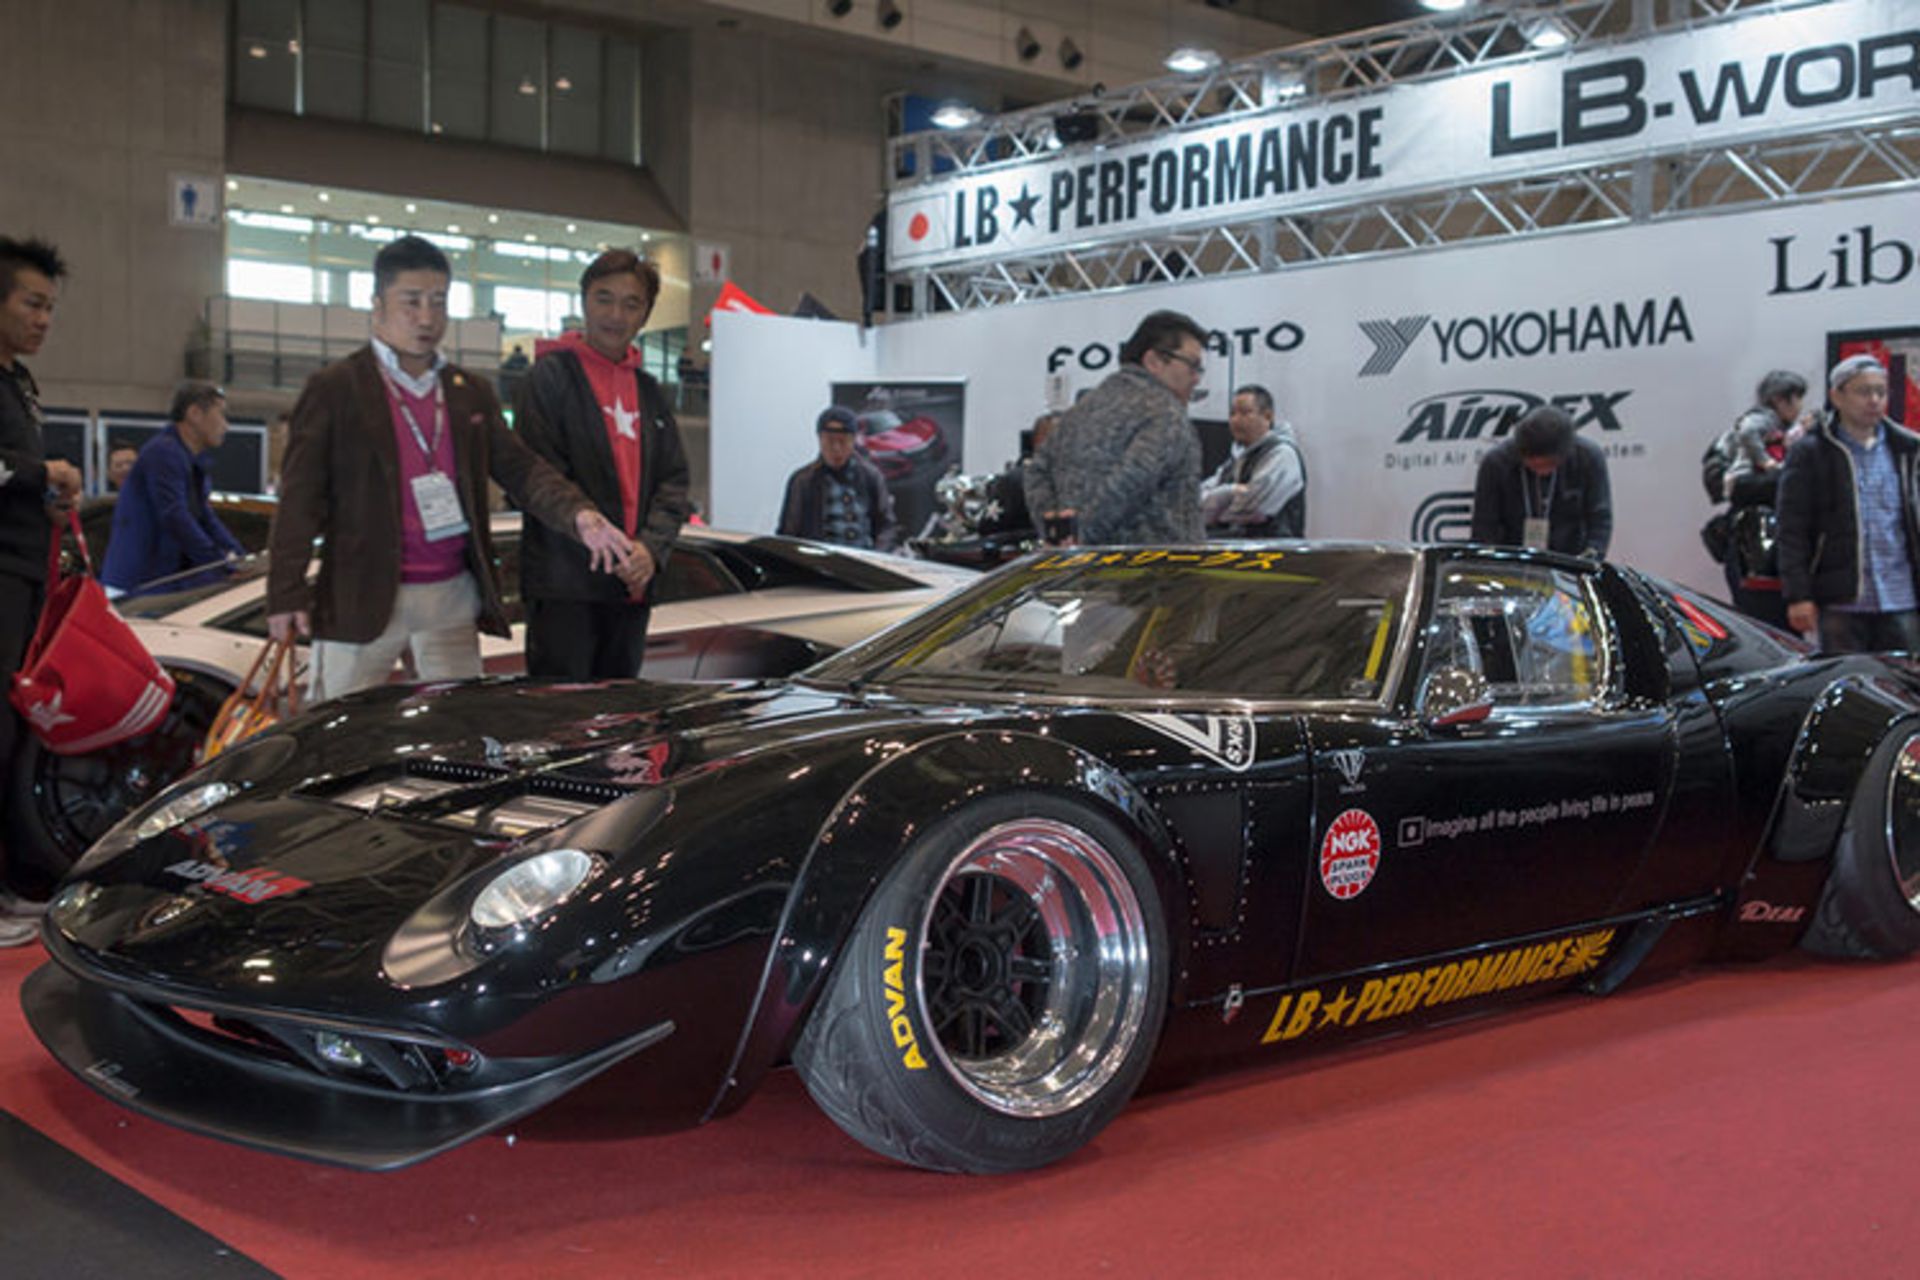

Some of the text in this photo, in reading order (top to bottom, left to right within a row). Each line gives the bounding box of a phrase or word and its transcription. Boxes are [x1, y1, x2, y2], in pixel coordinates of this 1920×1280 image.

[1767, 224, 1920, 297] Lib
[1047, 320, 1306, 374] FOATO
[1431, 295, 1695, 365] YOKOHAMA
[1384, 452, 1438, 471] Digital
[1443, 450, 1467, 466] Air
[1331, 828, 1372, 854] NGK
[1332, 857, 1368, 874] SPARK
[882, 926, 929, 1070] ADVAN
